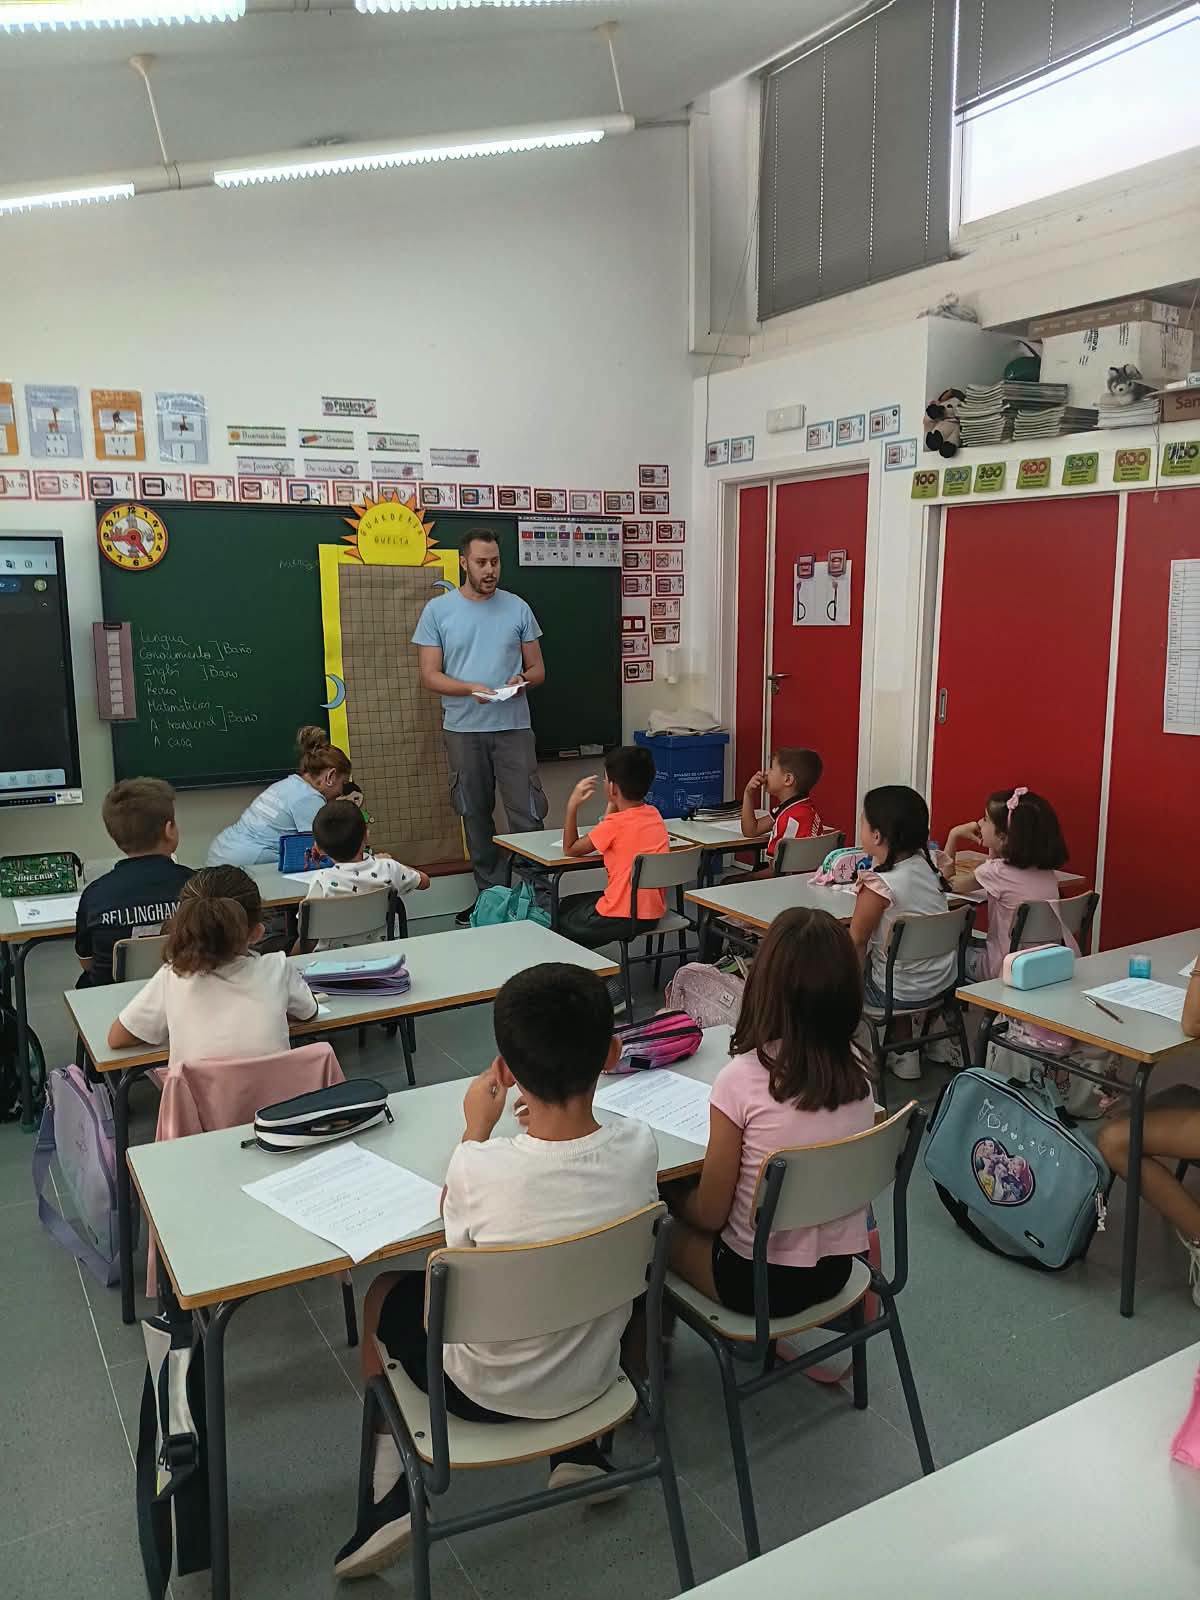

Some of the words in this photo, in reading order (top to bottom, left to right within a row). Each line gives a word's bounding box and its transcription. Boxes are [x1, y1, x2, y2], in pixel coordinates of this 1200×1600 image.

[914, 471, 937, 487] 100
[127, 506, 136, 514] 12
[112, 511, 120, 519] 11
[144, 511, 149, 519] 1
[152, 520, 160, 528] 2
[103, 532, 110, 540] 9
[157, 532, 164, 541] 3
[105, 544, 112, 553] 8
[117, 554, 123, 563] 7
[133, 559, 140, 567] 6
[147, 554, 154, 563] 5
[223, 641, 253, 655] Baño
[208, 664, 239, 679] Baño
